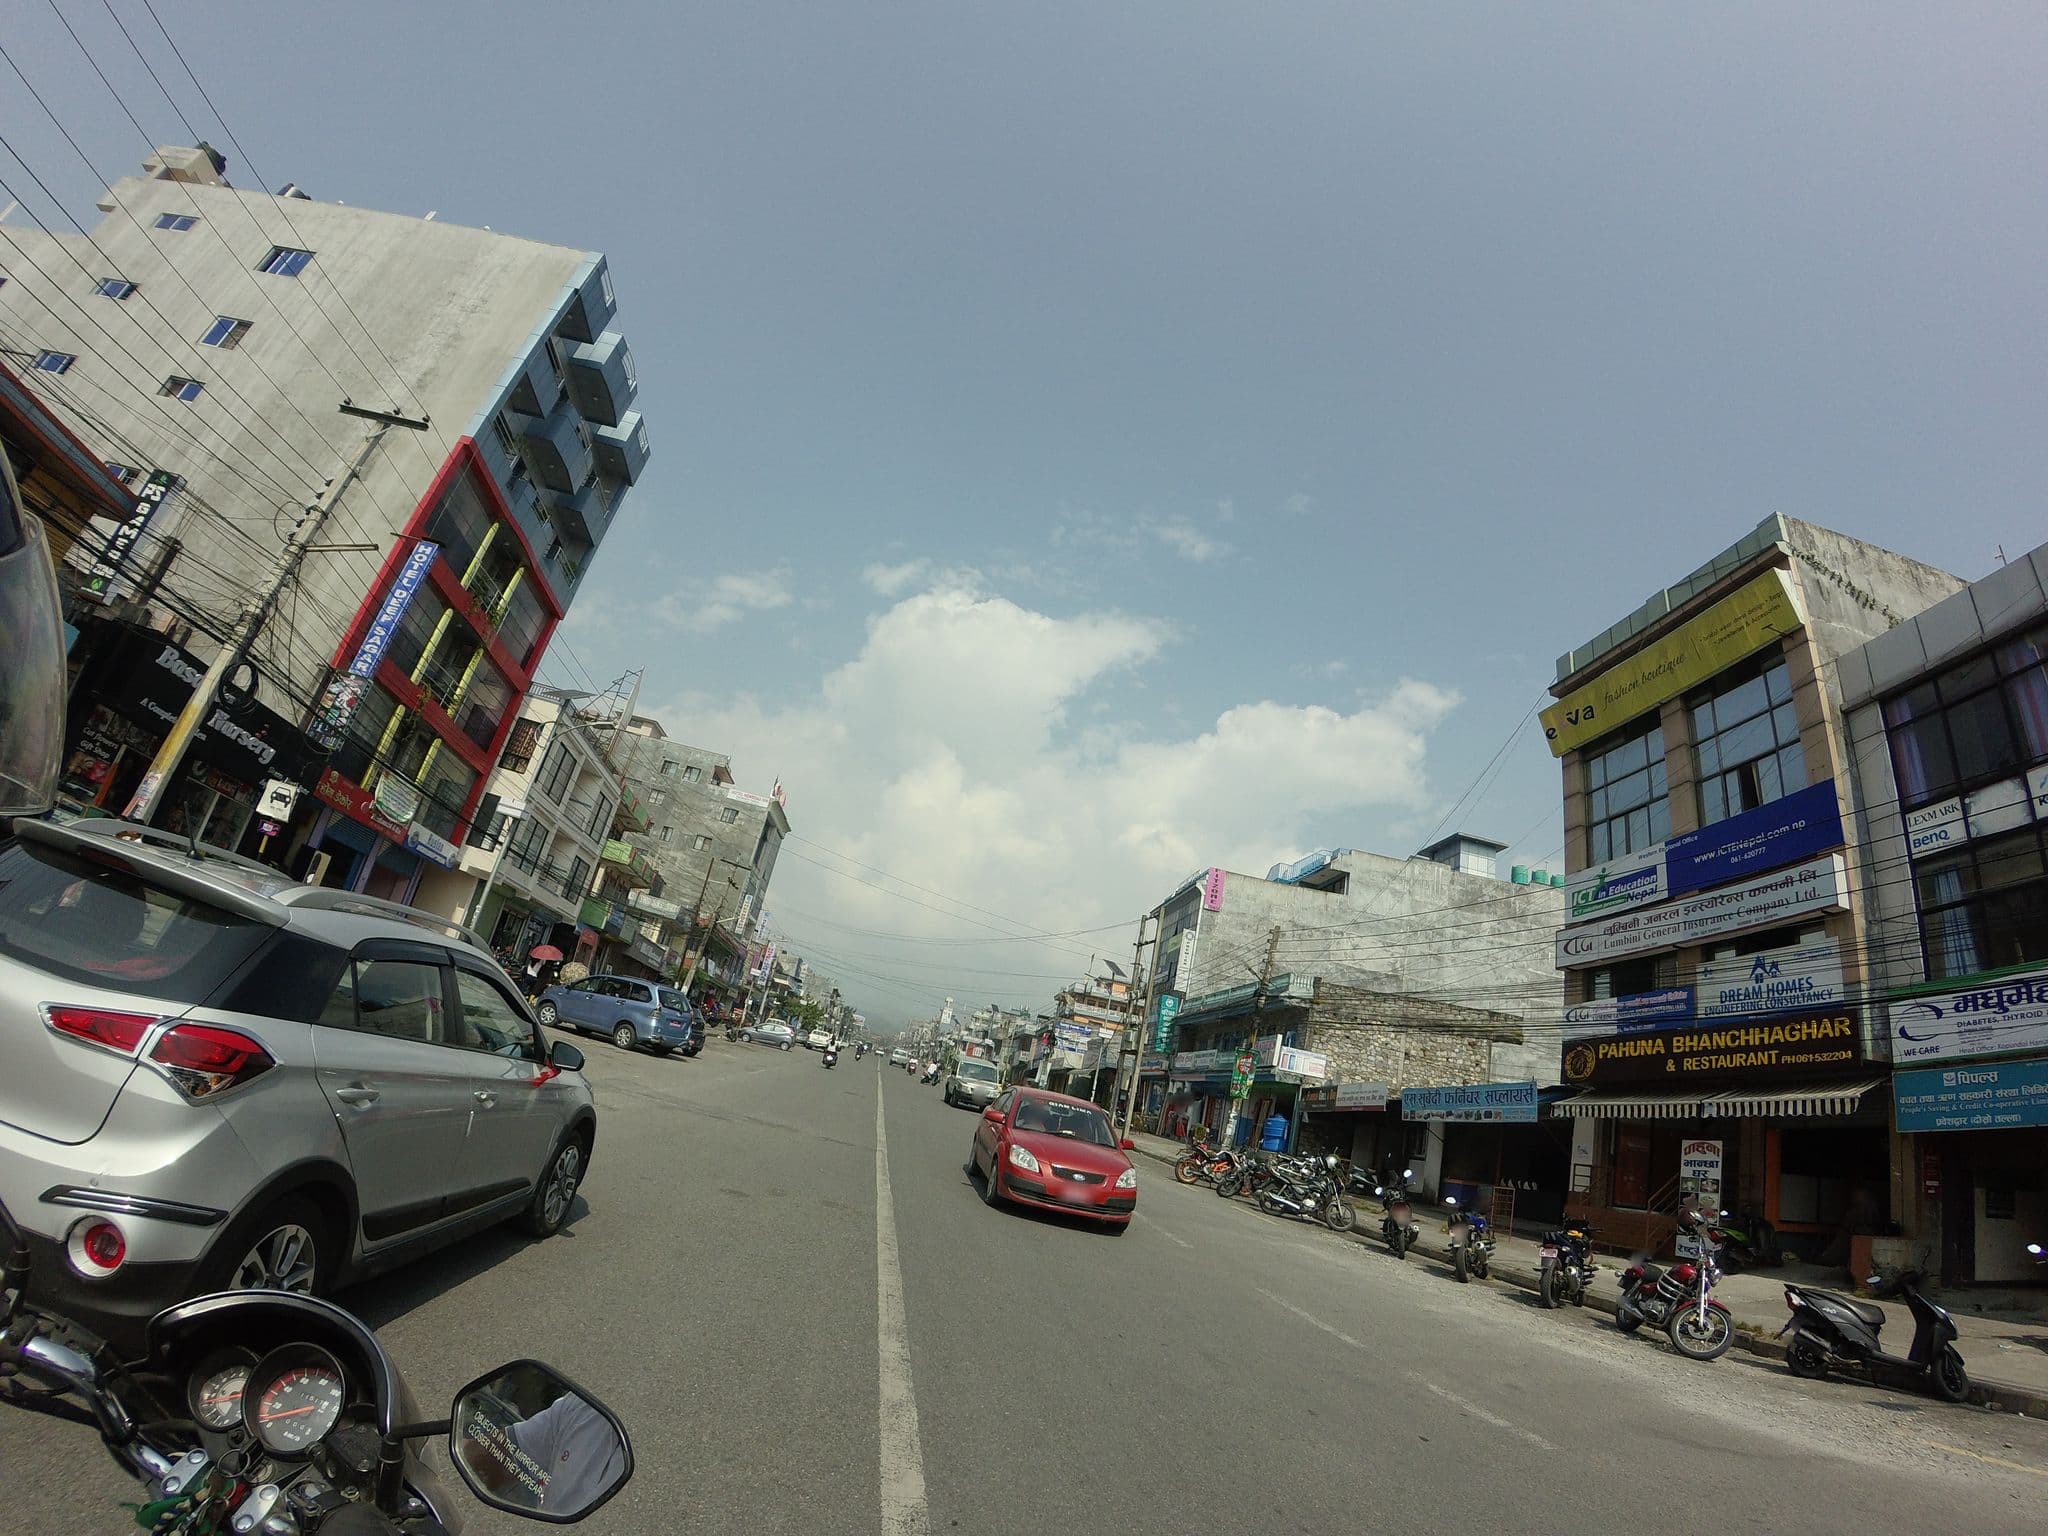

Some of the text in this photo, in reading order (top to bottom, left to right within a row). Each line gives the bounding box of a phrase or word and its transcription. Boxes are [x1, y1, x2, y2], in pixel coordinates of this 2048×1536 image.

[402, 544, 433, 587] HOTEL
[355, 627, 386, 672] SAGAR
[207, 708, 276, 765] Nursery
[1907, 803, 1961, 828] LEXMARK
[1913, 830, 1950, 849] BenQ
[1572, 886, 1597, 906] ICT
[1608, 875, 1657, 897] Education
[1626, 884, 1658, 903] Nepal
[1603, 931, 1641, 951] Lumbini
[1643, 921, 1681, 941] General
[1683, 912, 1734, 932] Insurance
[1737, 897, 1791, 918] Company
[1796, 887, 1821, 903] Ltd.
[1643, 908, 1680, 926] जनरल
[1704, 1000, 1763, 1017] ENGINEERING
[1764, 988, 1833, 1010] CONSULTANCY
[1720, 976, 1814, 1004] DREAM HOMES
[2001, 1010, 2044, 1022] THYROID
[1598, 1016, 1852, 1059] PAHUNA BHANCHHAGHAR
[1904, 1045, 1940, 1057] WE CARE
[1665, 1057, 1676, 1072] &
[1682, 1050, 1779, 1072] RESTAURANT
[1957, 1071, 1999, 1085] पिपल्स
[1691, 1169, 1709, 1178] घर
[468, 1423, 491, 1450] CLOSER
[489, 1442, 506, 1464] THAN
[503, 1457, 520, 1477] THEY
[474, 1411, 499, 1438] OBJECTS
[504, 1437, 517, 1455] THE
[514, 1450, 540, 1475] MIRROR
[537, 1469, 552, 1486] ARE
